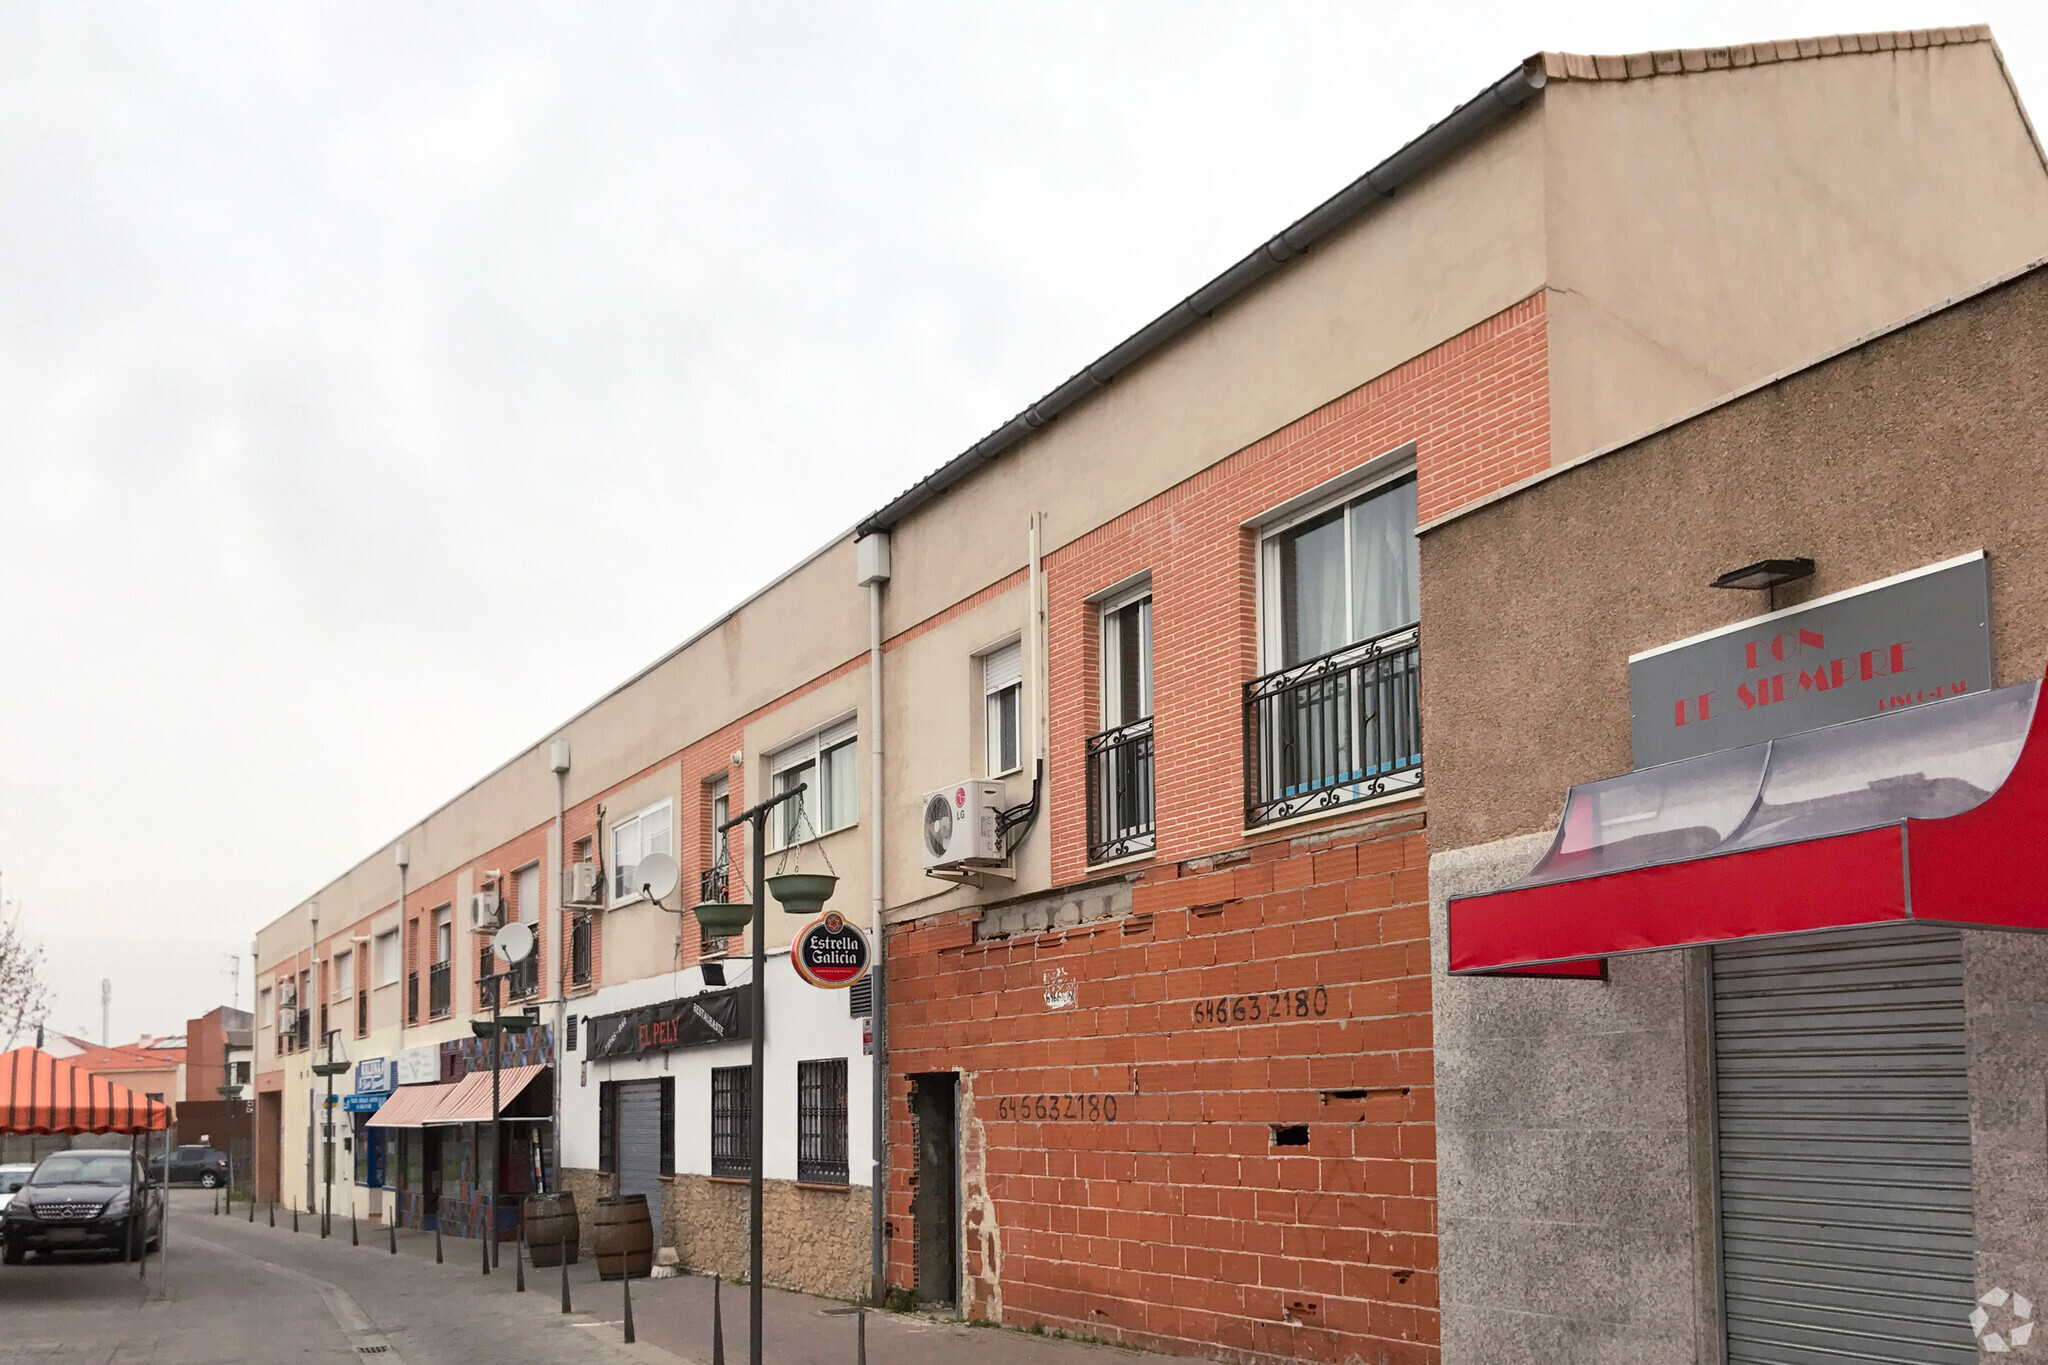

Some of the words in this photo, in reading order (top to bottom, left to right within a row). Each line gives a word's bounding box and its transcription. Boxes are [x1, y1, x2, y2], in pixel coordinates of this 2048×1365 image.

[1745, 621, 1824, 670] DON
[1675, 690, 1719, 727] DE
[1737, 640, 1916, 711] SIEMPRE
[956, 809, 965, 820] LG
[810, 936, 858, 950] Estrella
[812, 950, 856, 964] Galicia
[638, 1024, 651, 1047] EL
[653, 1014, 681, 1044] PELY
